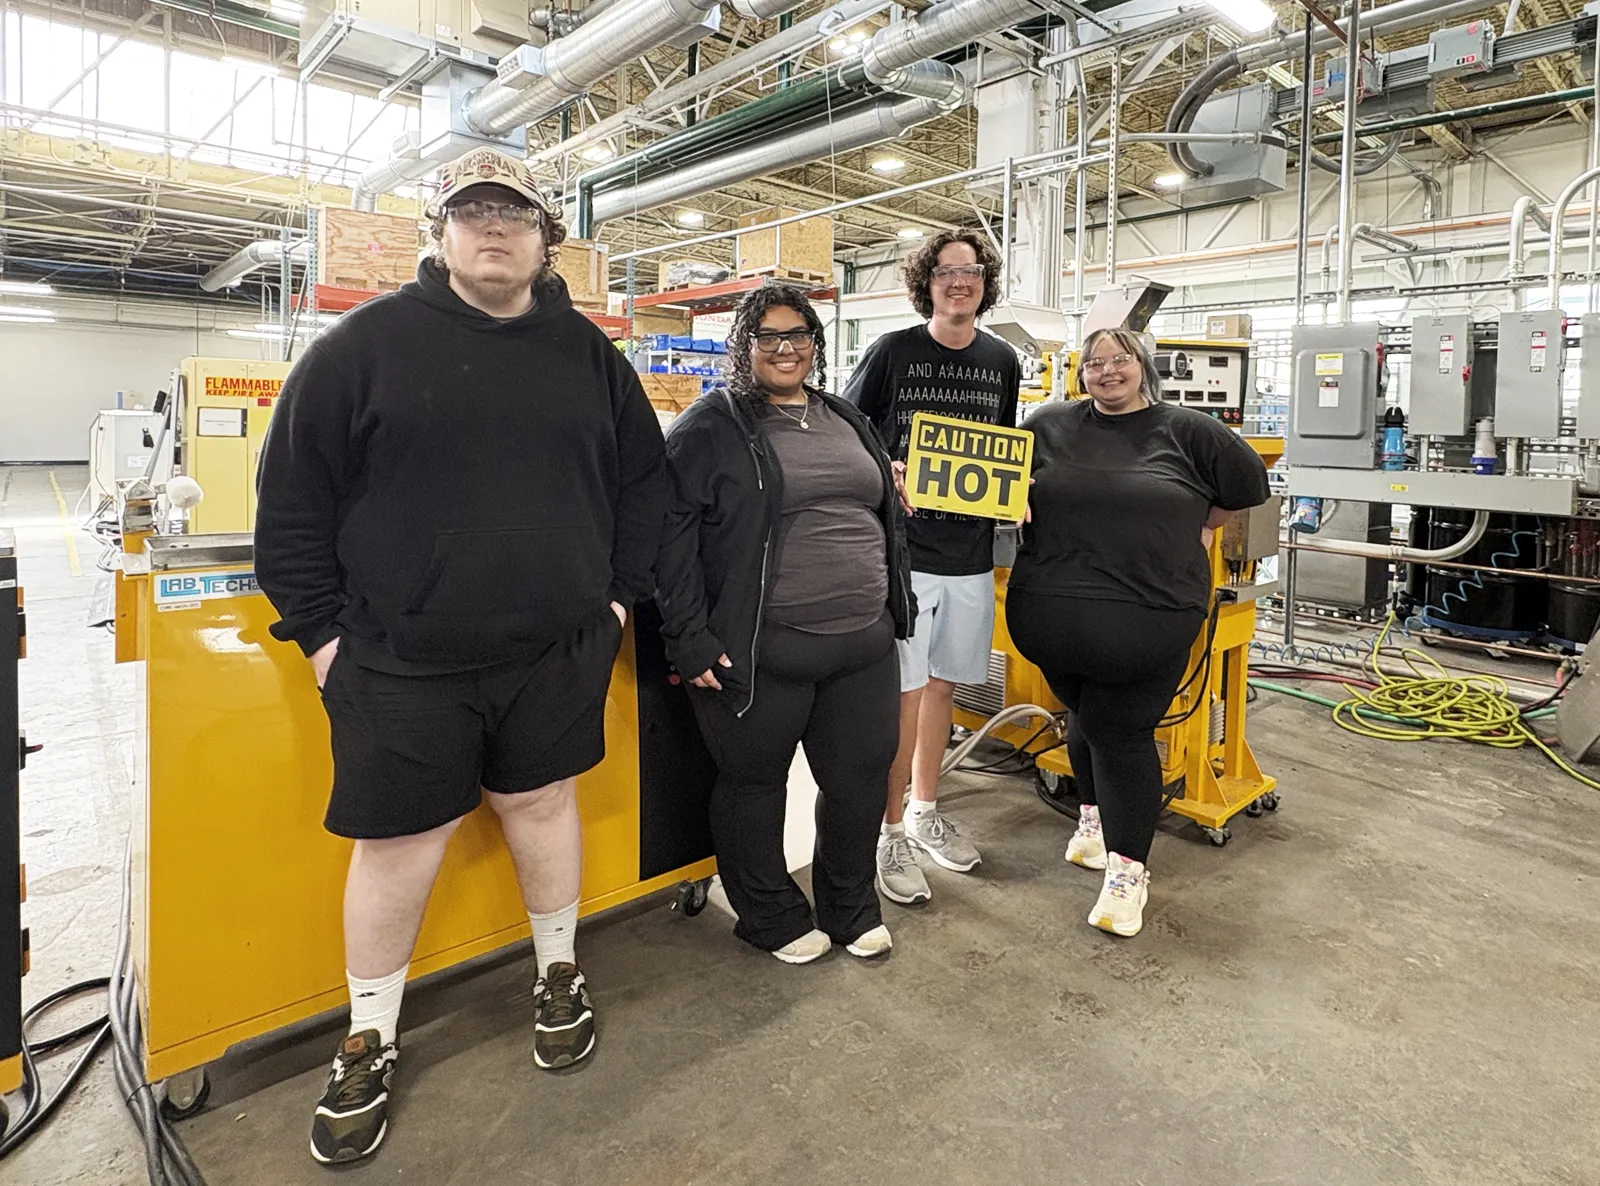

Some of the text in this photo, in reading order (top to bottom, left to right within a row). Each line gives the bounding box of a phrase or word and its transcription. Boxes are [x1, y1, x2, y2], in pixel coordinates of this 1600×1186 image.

[456, 151, 518, 178] ARSENAL
[920, 424, 1025, 462] CAUTION
[916, 456, 1022, 507] HOT
